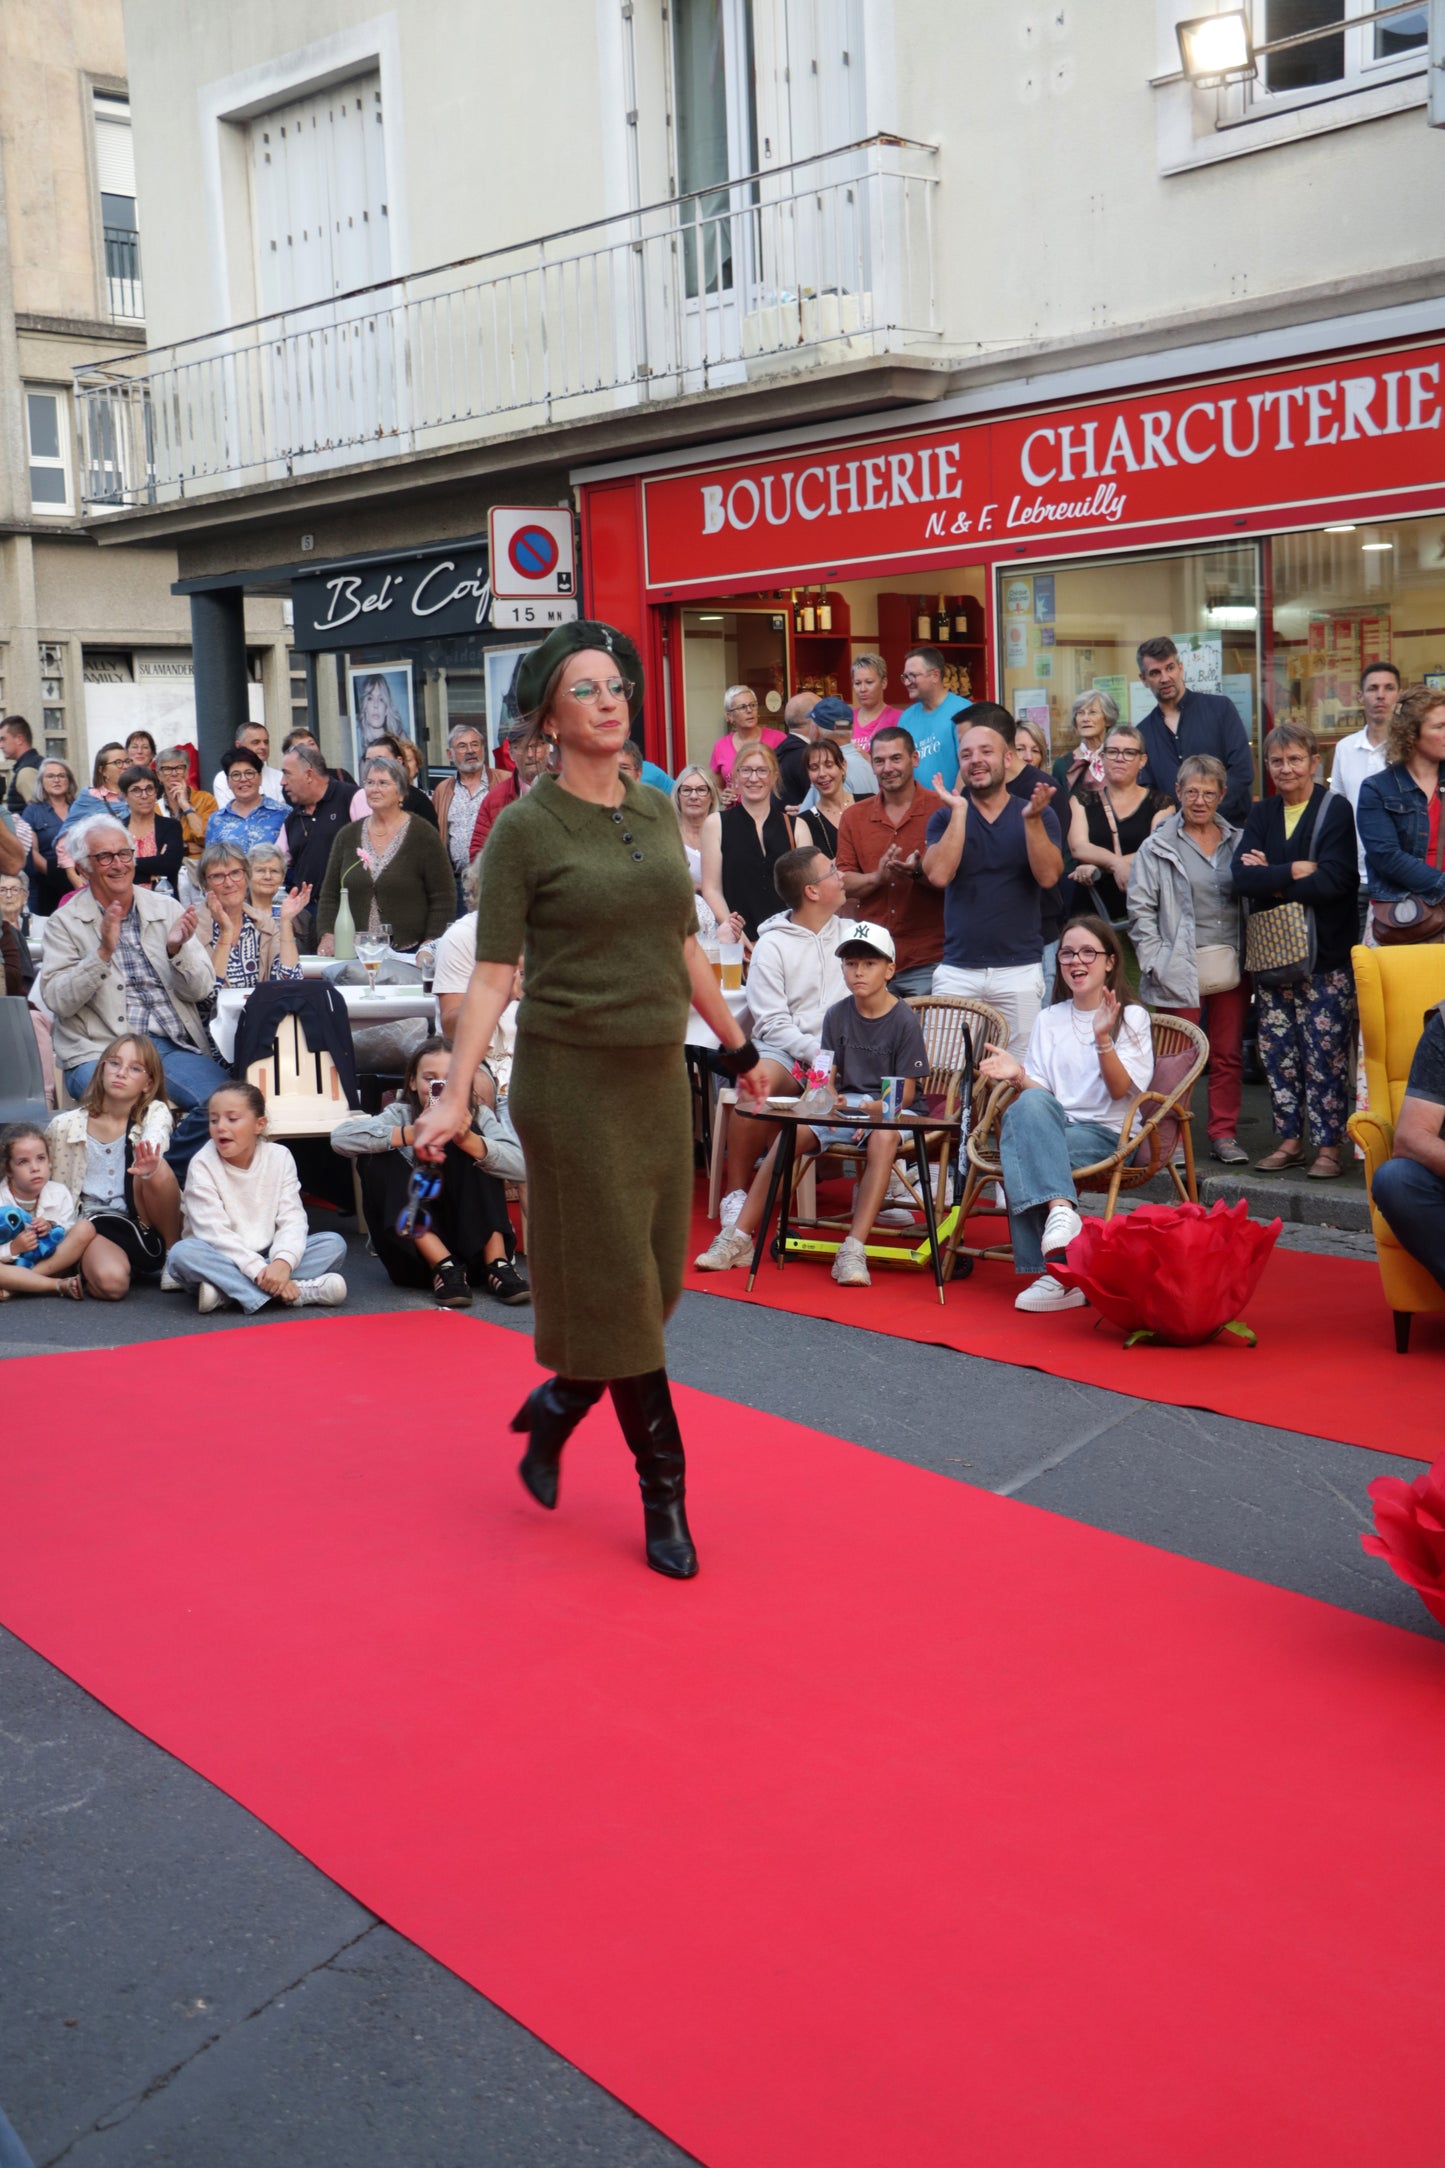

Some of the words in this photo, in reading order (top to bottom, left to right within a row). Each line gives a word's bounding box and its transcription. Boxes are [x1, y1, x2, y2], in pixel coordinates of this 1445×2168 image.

[700, 442, 963, 535] BOUCHERIE
[1020, 362, 1443, 487] CHARCUTERIE
[925, 511, 947, 538] N.
[951, 511, 973, 534] &
[978, 504, 998, 532] F.
[1006, 482, 1127, 528] Lebreuilly
[512, 607, 535, 622] 15
[548, 611, 562, 621] MN
[853, 924, 870, 938] NY
